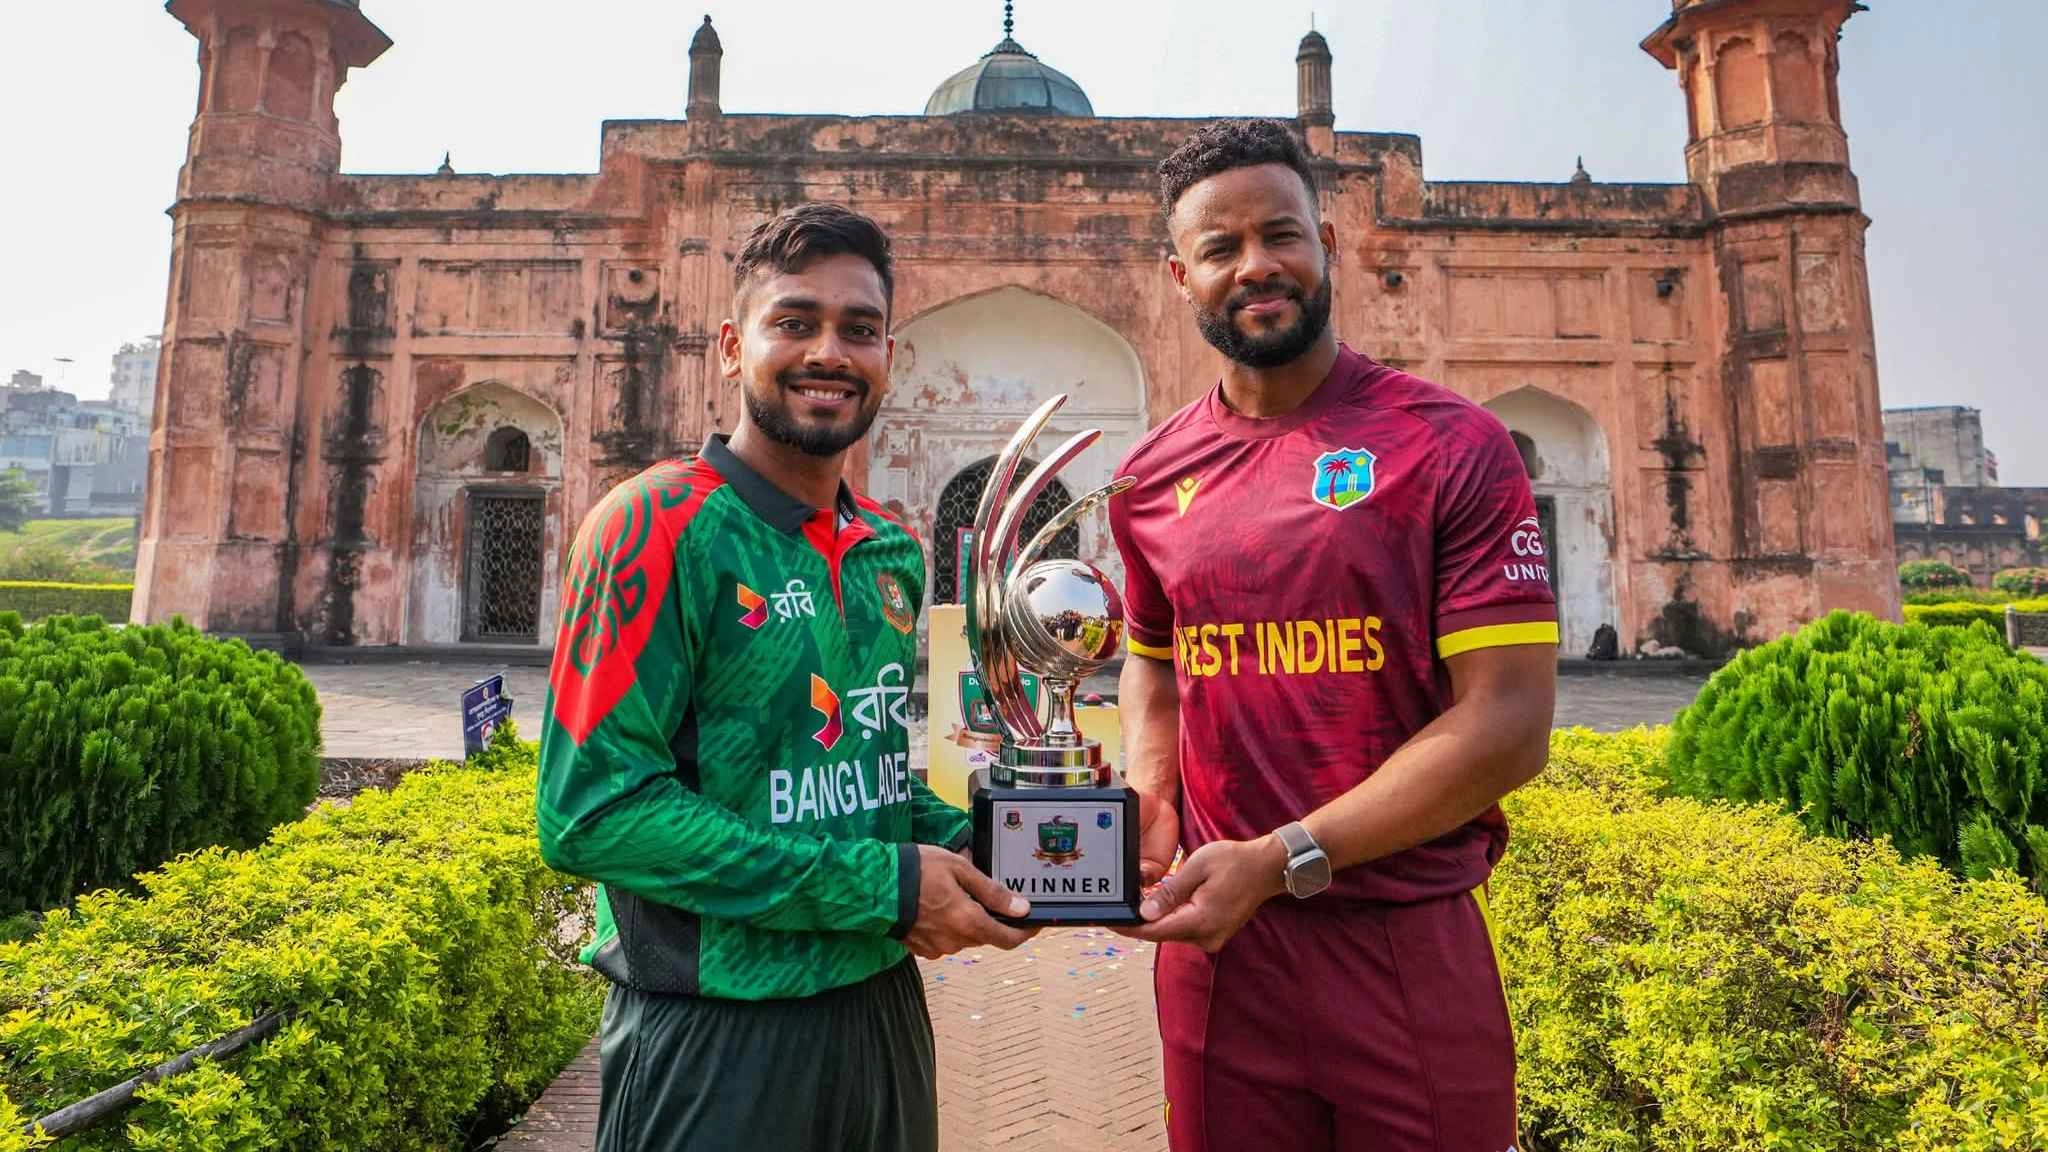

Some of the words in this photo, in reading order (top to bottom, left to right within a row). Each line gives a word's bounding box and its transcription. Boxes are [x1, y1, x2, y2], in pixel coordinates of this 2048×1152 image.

[1511, 530, 1544, 557] CG
[1503, 564, 1549, 583] UNIT
[770, 579, 816, 624] রবি
[1175, 623, 1244, 678] WEST
[1255, 616, 1385, 675] INDIES
[847, 662, 909, 740] রবি
[769, 752, 912, 824] BANGLADE
[1005, 877, 1110, 893] WINNER
